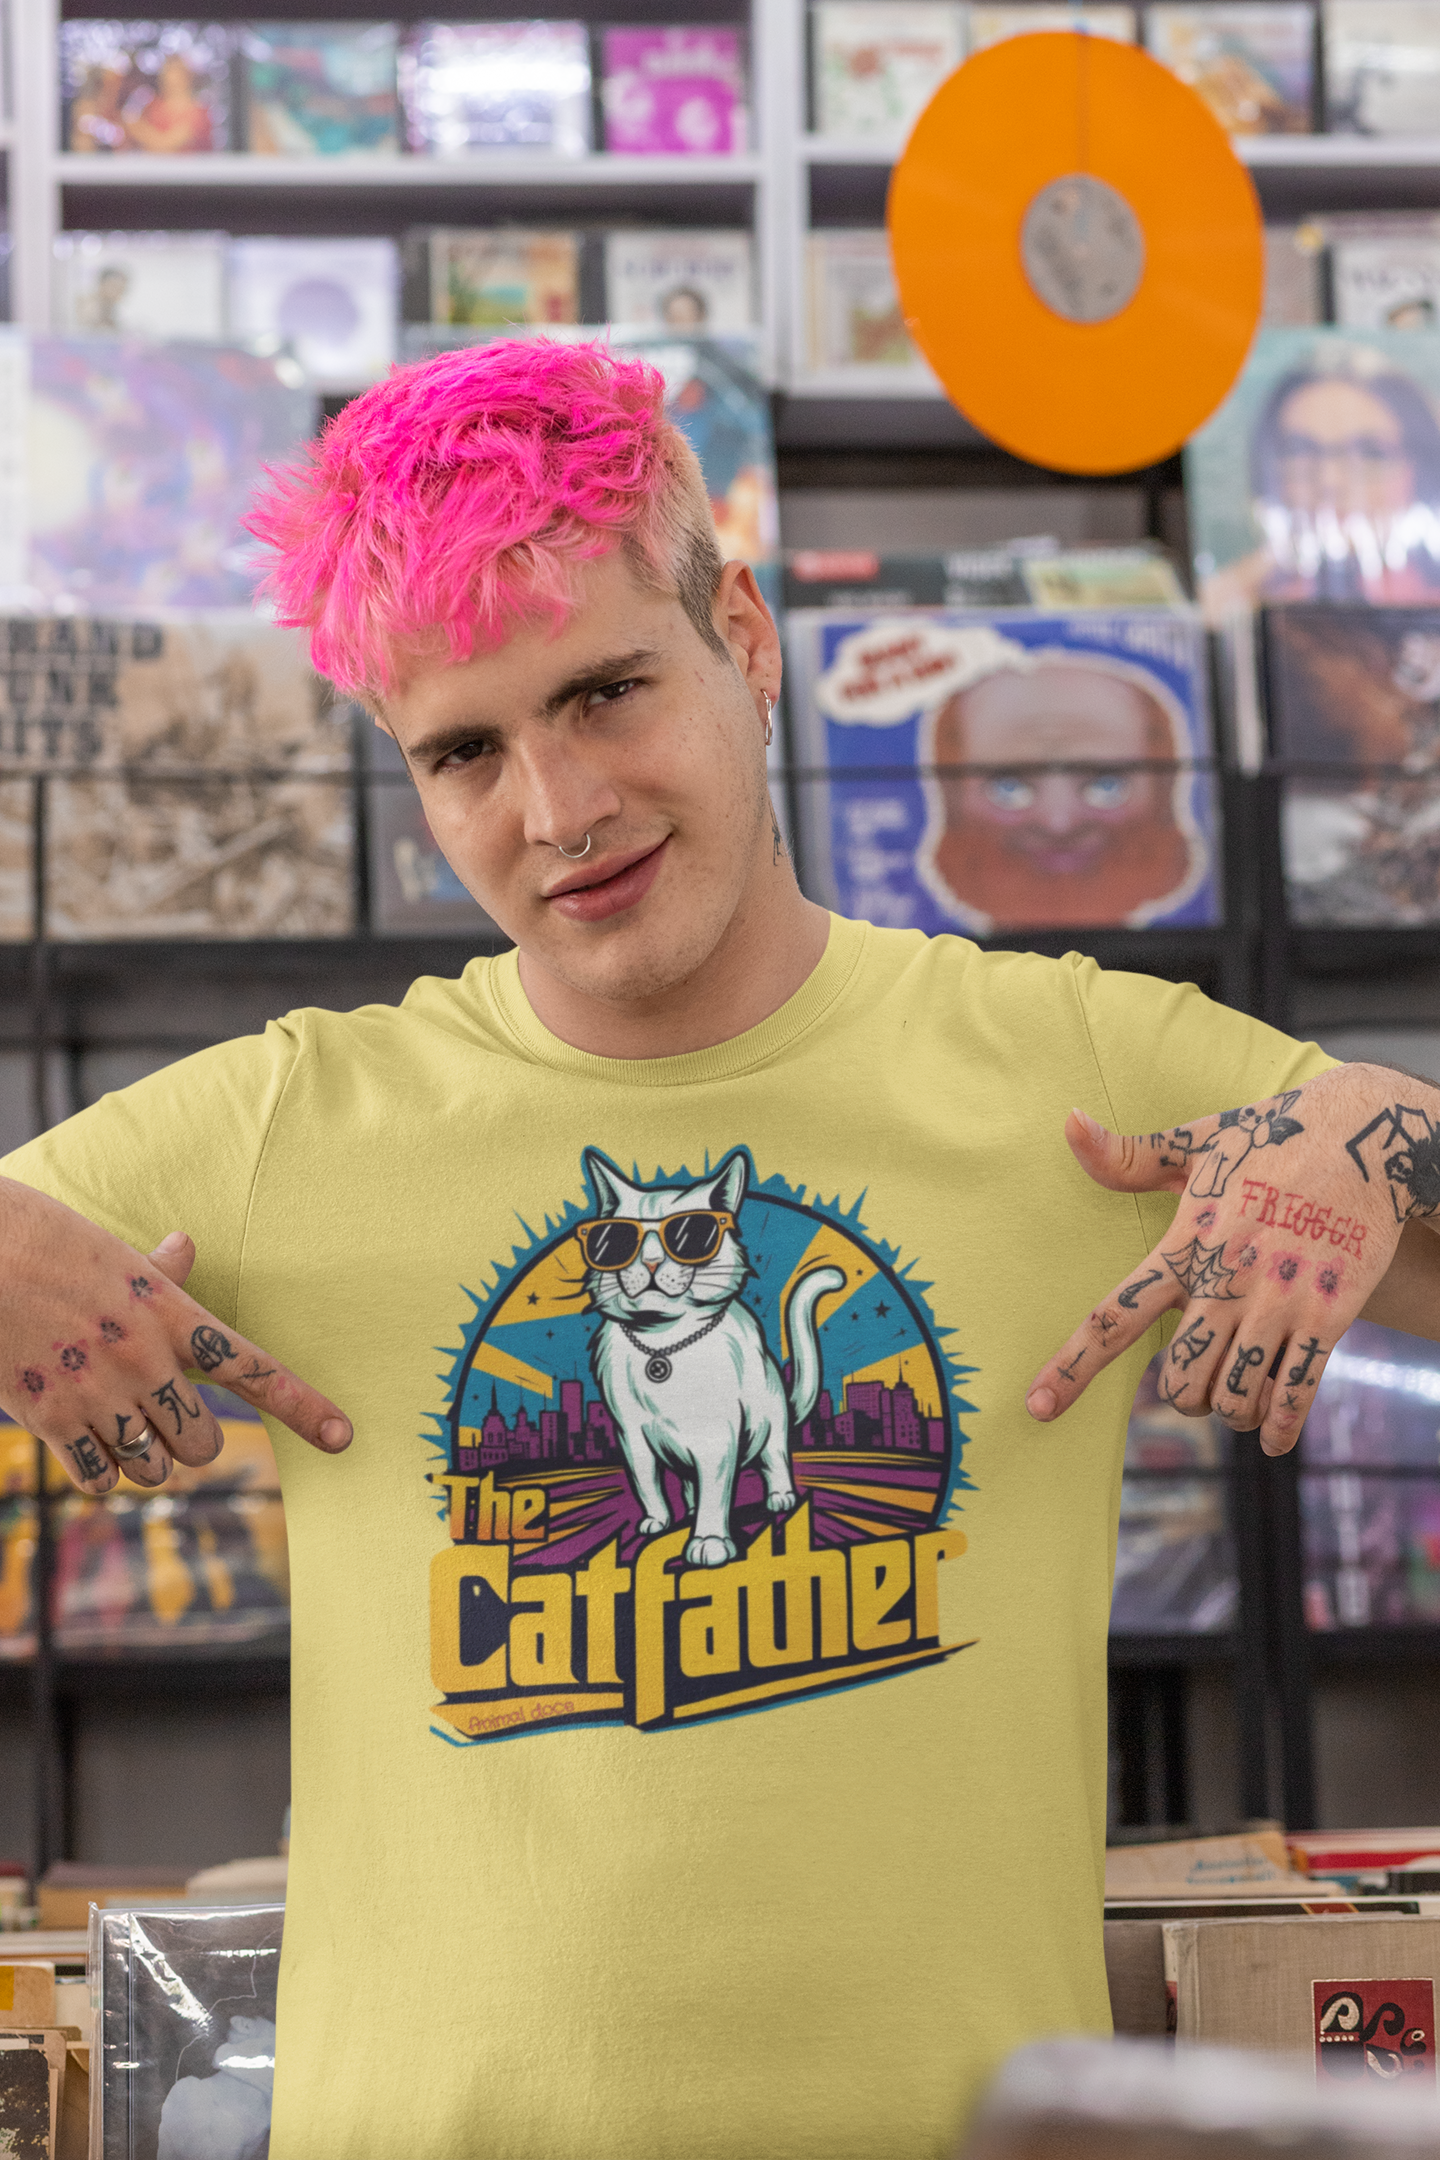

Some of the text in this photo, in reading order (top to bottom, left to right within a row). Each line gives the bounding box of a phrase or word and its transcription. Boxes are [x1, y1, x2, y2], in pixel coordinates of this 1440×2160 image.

[0, 619, 164, 660] RAND
[0, 667, 120, 710] UNK
[0, 717, 104, 760] ITS
[432, 1470, 546, 1541] The
[429, 1500, 969, 1727] Catfather
[468, 1701, 575, 1732] Animal doce
